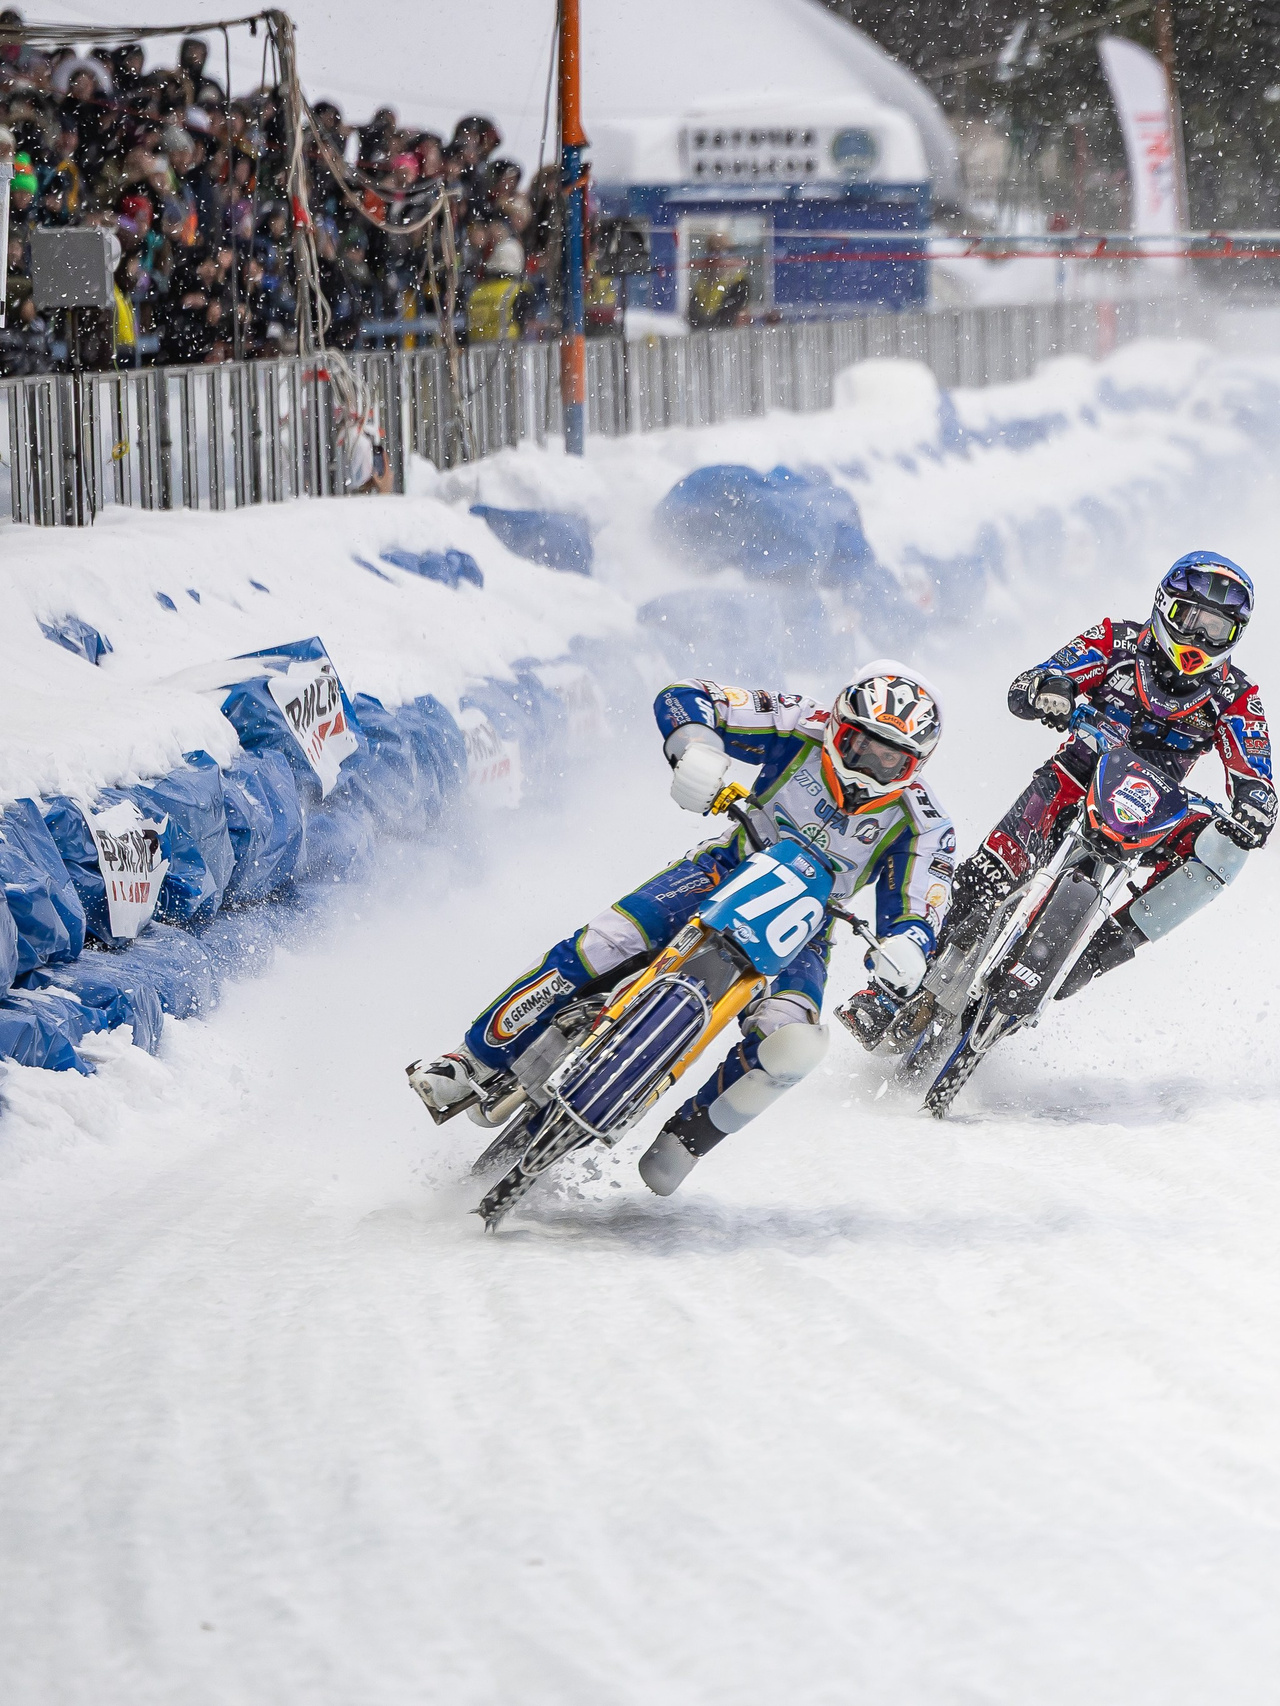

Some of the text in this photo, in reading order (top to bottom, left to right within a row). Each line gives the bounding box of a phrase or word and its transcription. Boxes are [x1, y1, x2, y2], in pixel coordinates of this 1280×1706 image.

[1113, 639, 1137, 654] DEKR
[795, 769, 823, 797] 776
[814, 798, 850, 836] UFA
[1115, 790, 1152, 815] ПРИМОРЬЕ
[971, 852, 1011, 895] EKRA
[1010, 961, 1042, 990] 106
[502, 1017, 514, 1032] JB
[511, 986, 552, 1023] GERMAN
[551, 975, 568, 992] OIL
